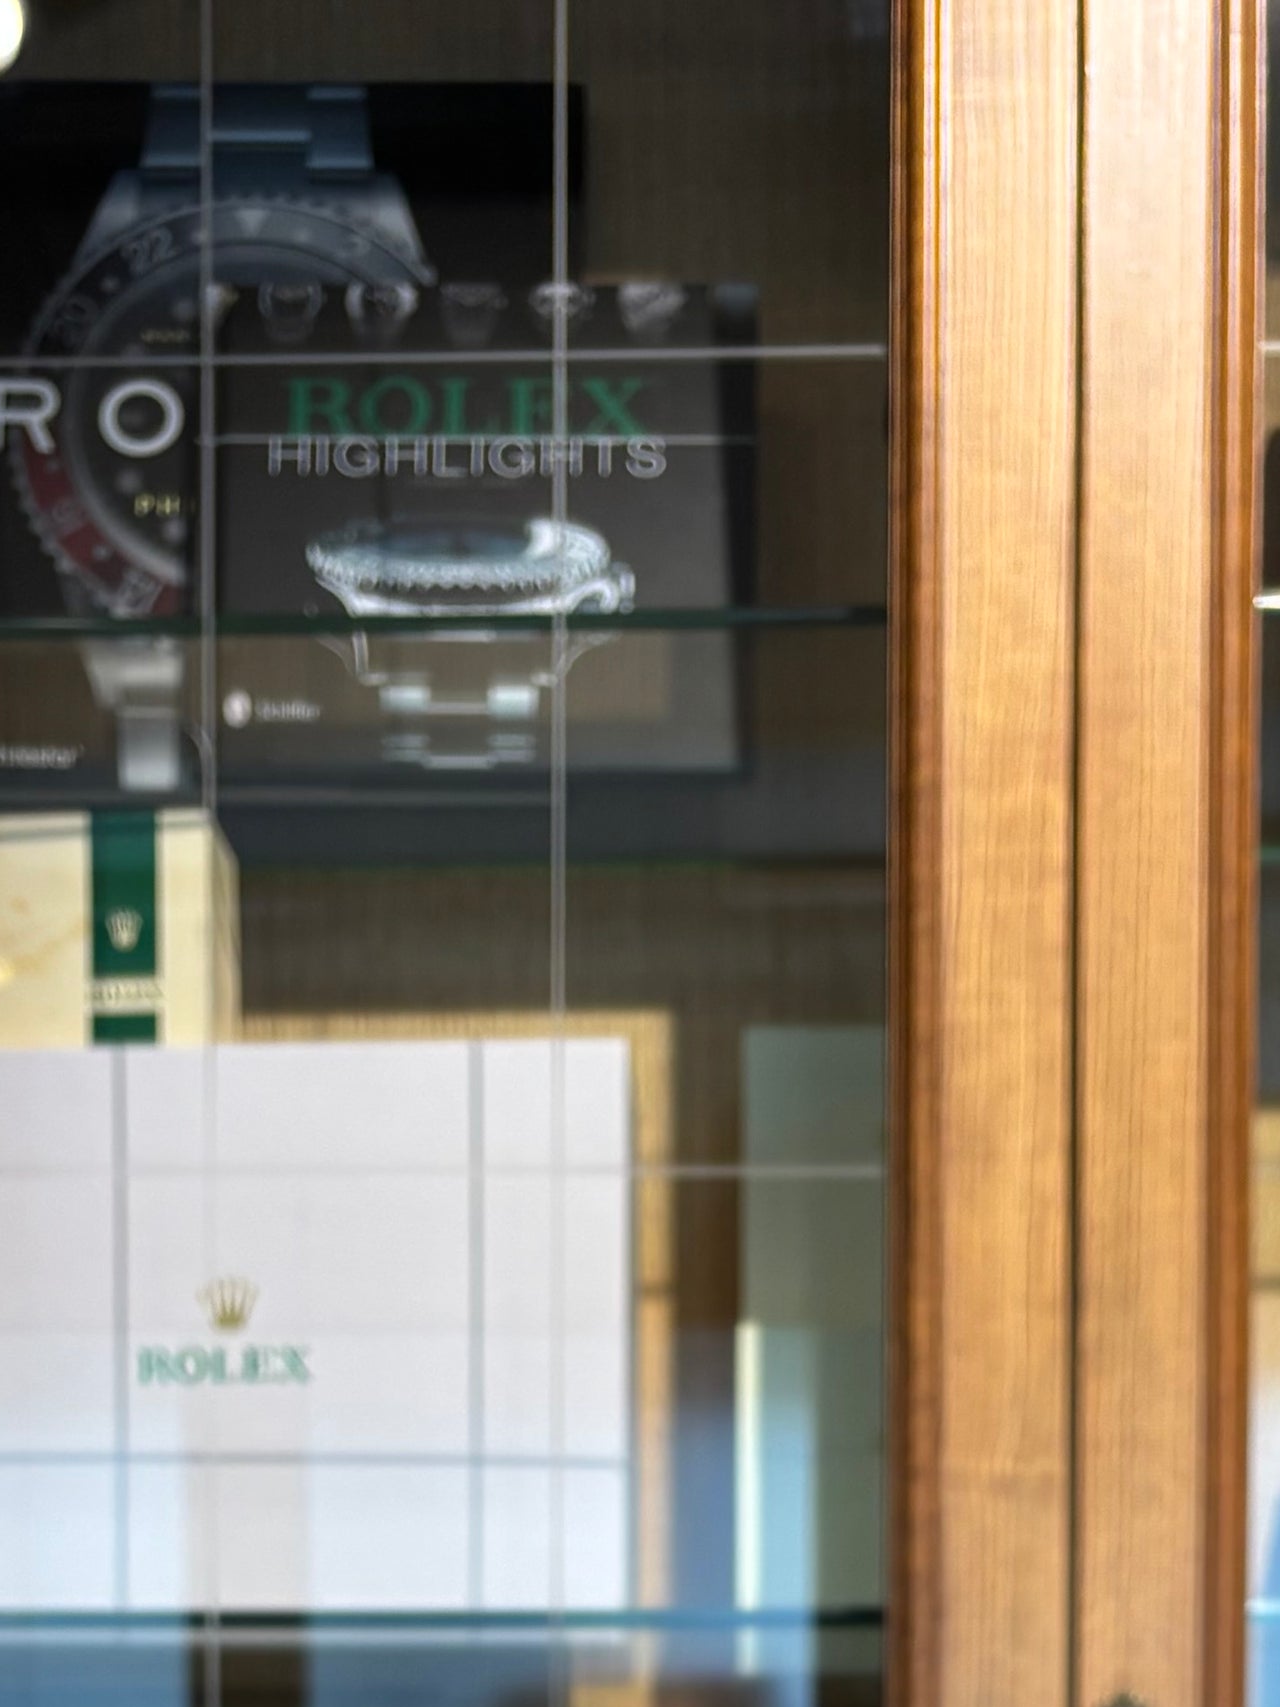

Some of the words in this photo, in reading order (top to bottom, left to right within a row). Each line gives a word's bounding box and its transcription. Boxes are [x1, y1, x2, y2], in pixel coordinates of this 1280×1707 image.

[282, 374, 652, 437] ROLEX
[267, 433, 669, 480] HIGHLIGHTS
[136, 1343, 313, 1386] ROLEX
